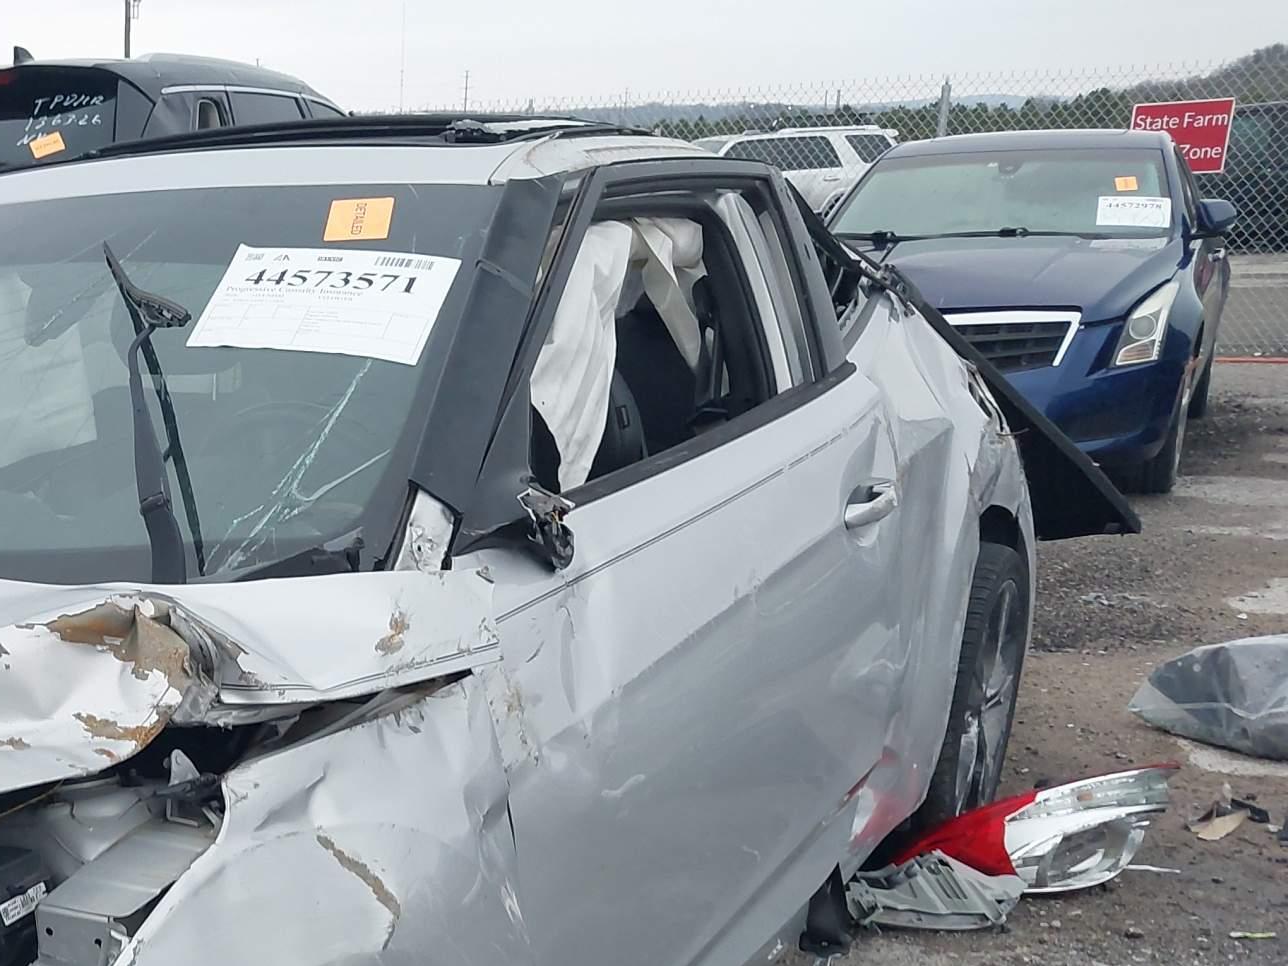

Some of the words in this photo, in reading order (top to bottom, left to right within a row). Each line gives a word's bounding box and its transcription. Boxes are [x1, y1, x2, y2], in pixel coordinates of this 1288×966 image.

[1135, 114, 1180, 131] State
[1183, 111, 1228, 128] Farm
[1179, 144, 1222, 160] Zone
[244, 267, 418, 294] 44573571
